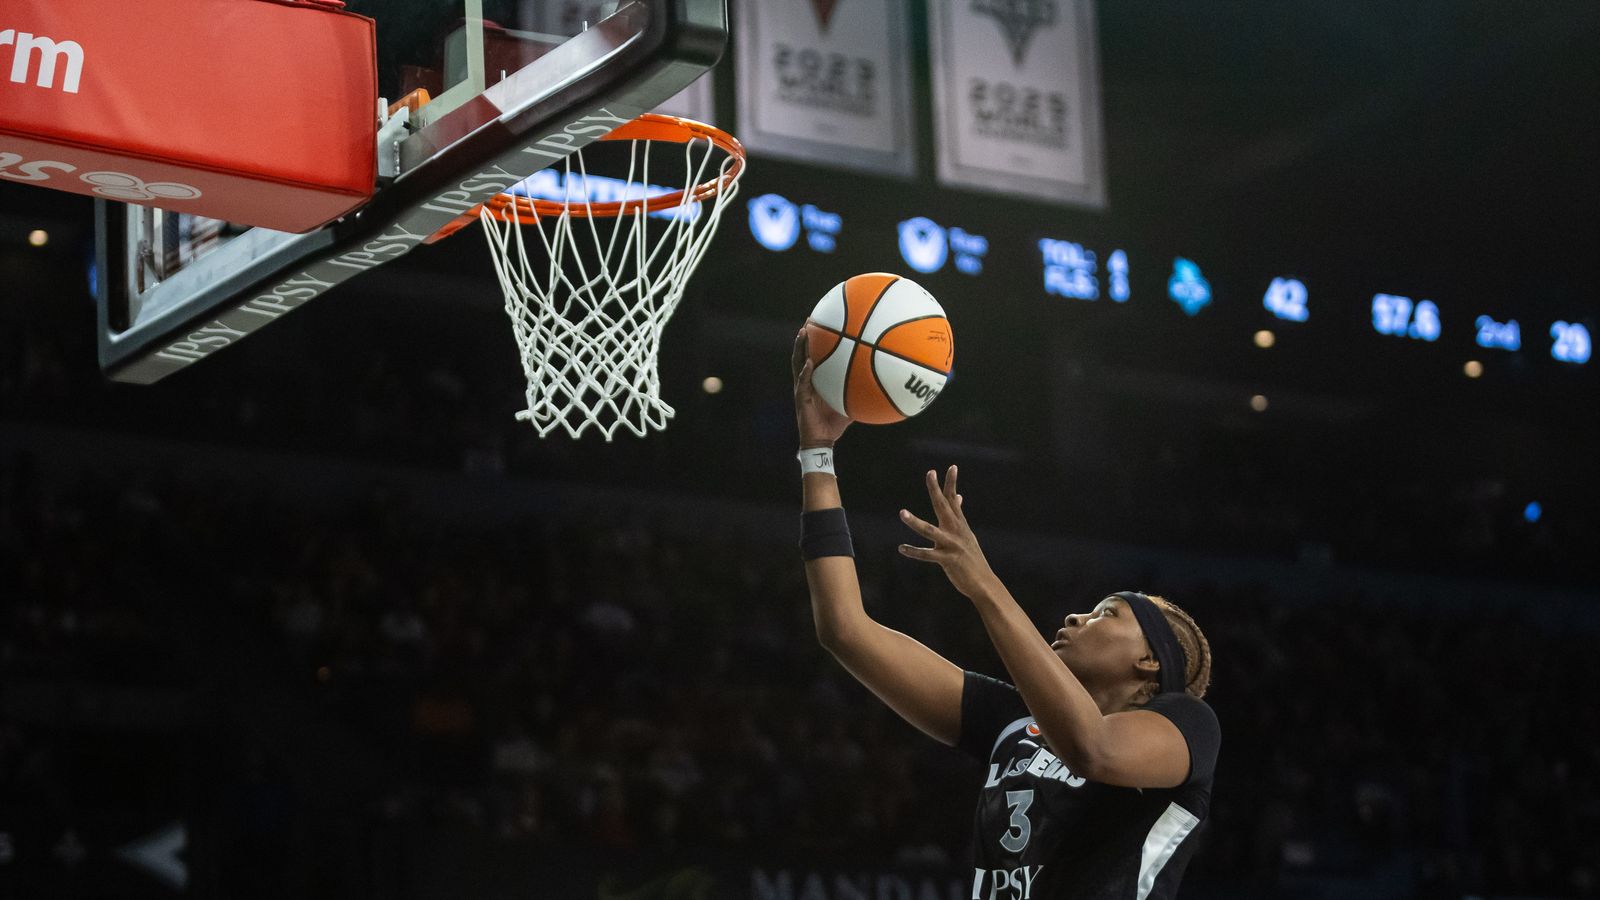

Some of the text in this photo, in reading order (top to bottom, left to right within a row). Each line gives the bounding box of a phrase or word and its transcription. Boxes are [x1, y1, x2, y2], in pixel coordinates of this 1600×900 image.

[154, 320, 249, 363] IPSY
[240, 271, 336, 318] IPSY
[328, 223, 427, 270] IPSY
[421, 164, 526, 216] IPSY
[522, 107, 631, 160] IPSY
[1263, 276, 1309, 322] 42
[999, 789, 1034, 853] 3
[972, 864, 1044, 900] IPSY
